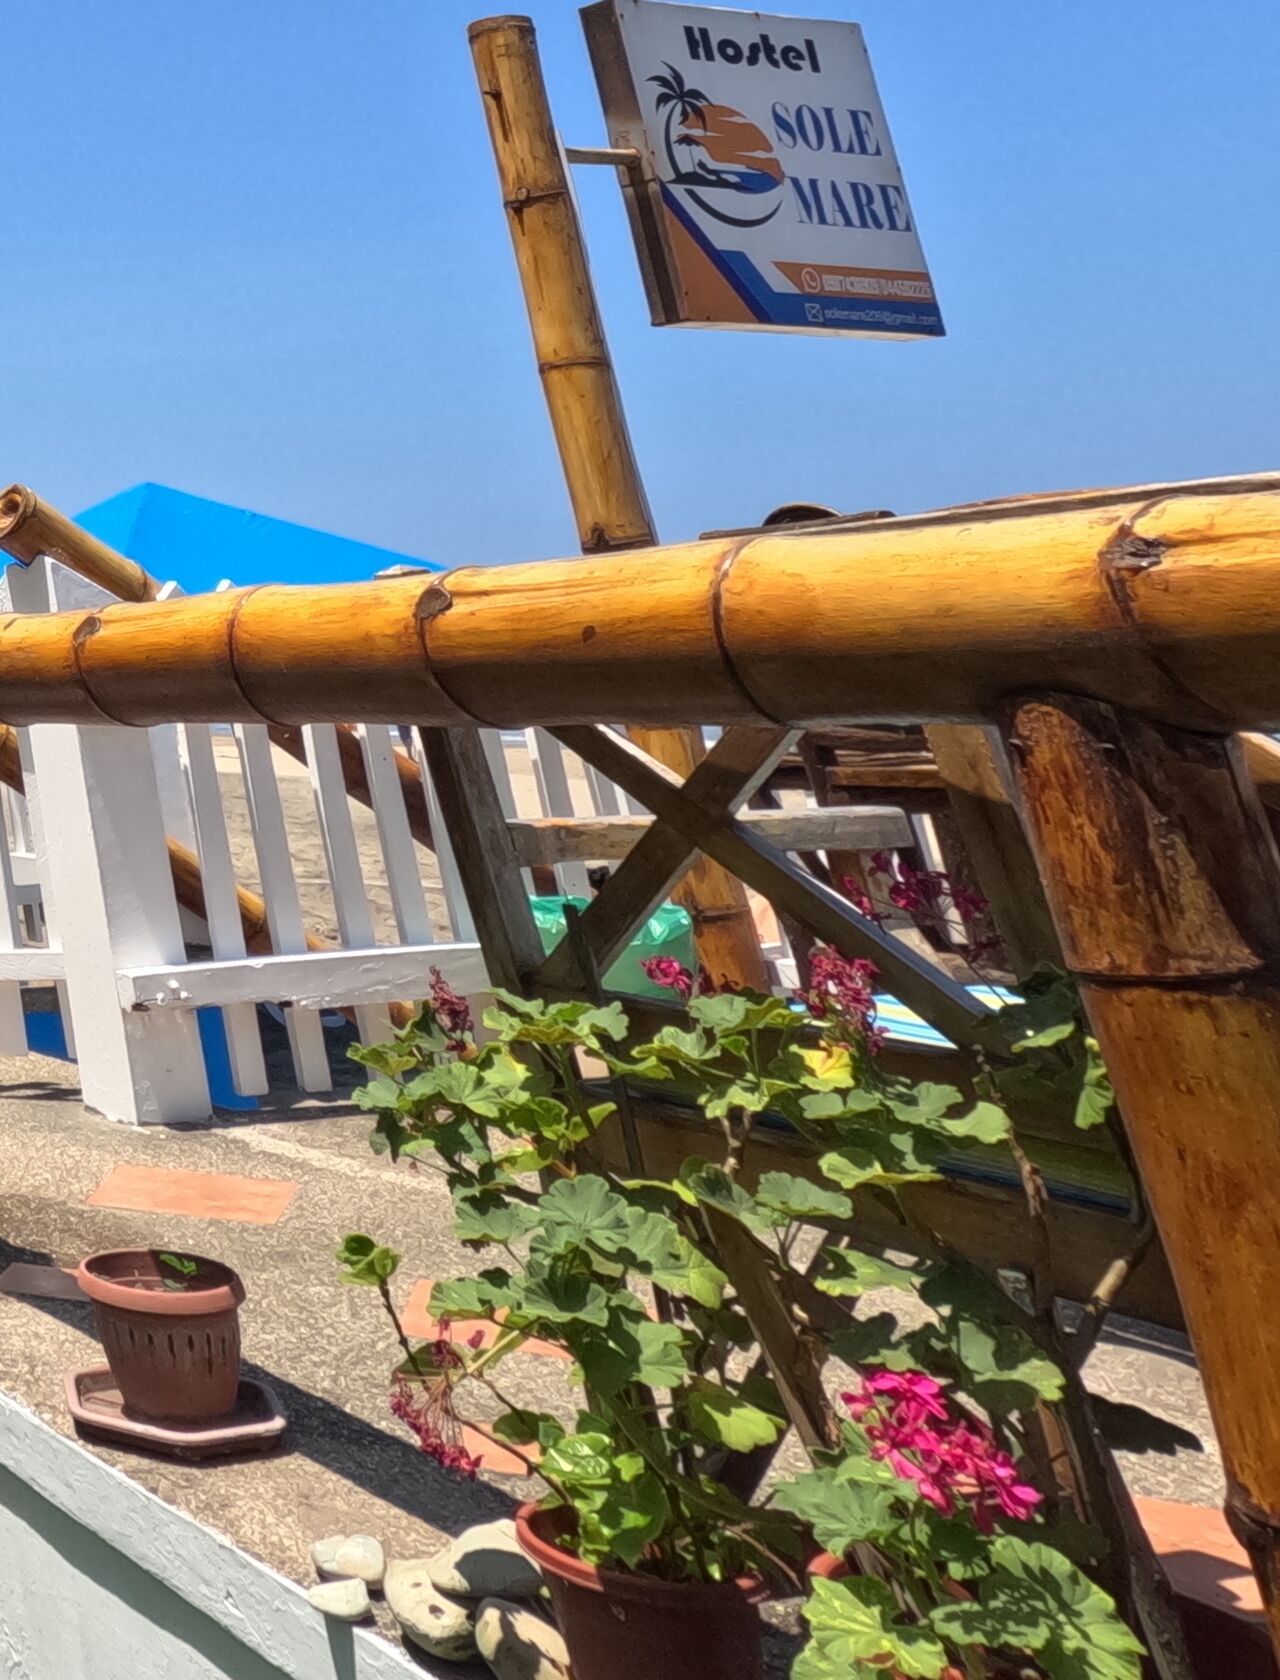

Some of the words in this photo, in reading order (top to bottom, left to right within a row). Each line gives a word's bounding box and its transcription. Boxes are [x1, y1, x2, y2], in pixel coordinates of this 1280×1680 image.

[683, 25, 821, 73] Hostel
[771, 101, 882, 156] SOLE
[785, 175, 912, 232] MARE
